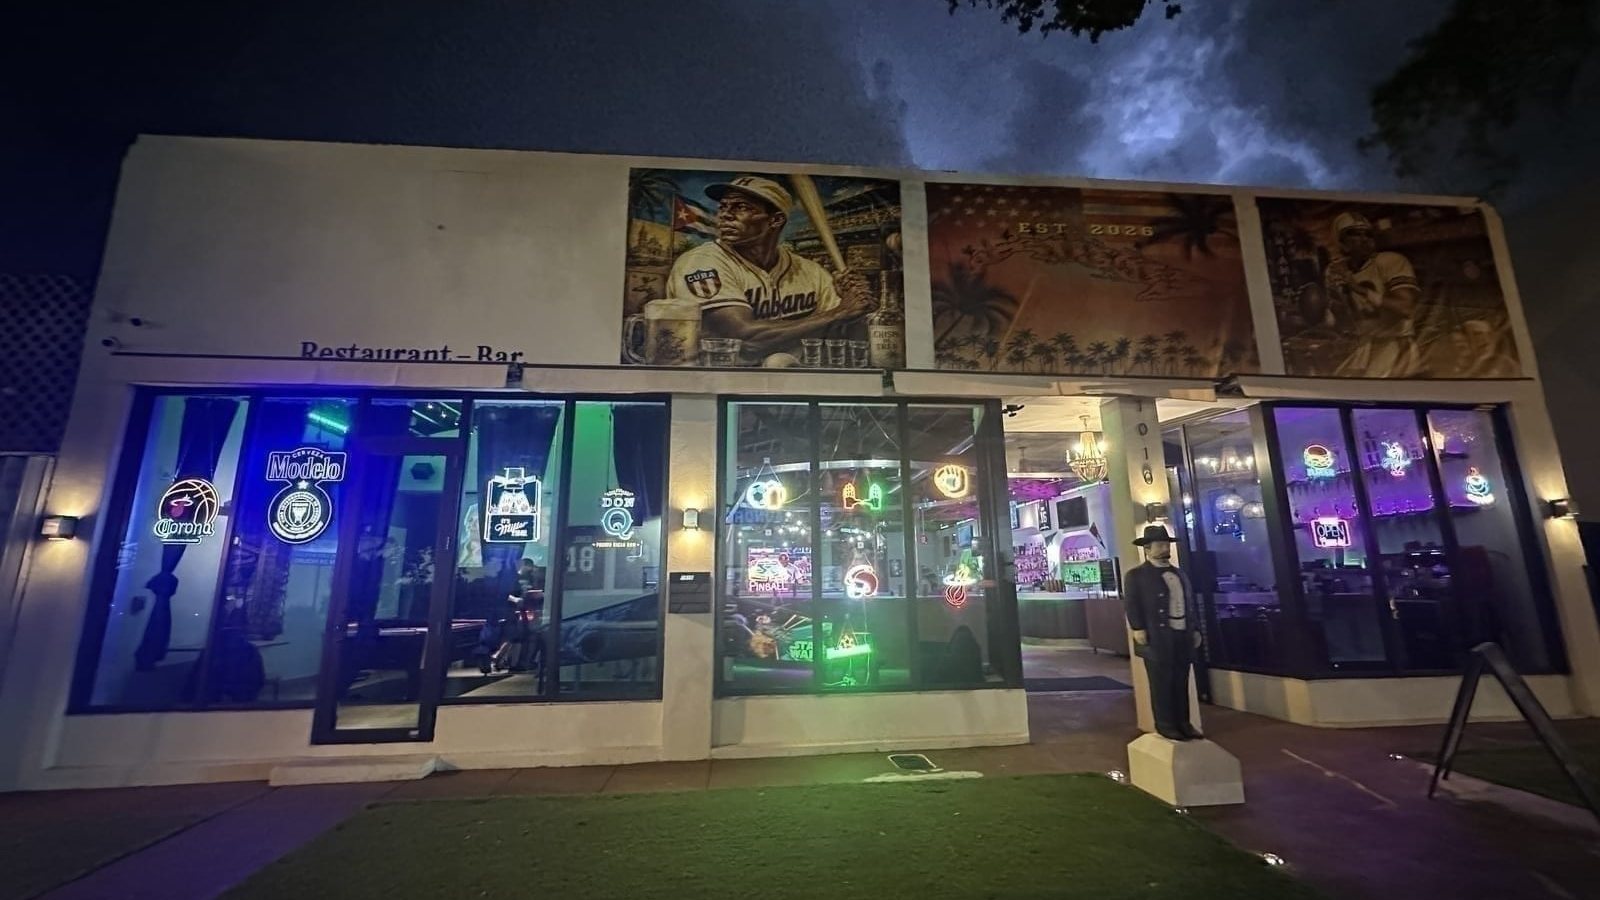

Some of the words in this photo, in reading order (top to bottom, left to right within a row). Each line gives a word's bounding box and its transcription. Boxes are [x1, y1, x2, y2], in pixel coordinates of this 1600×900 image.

[1018, 222, 1067, 234] EST
[1090, 224, 1153, 237] 2026
[687, 271, 715, 283] CUBA
[745, 288, 817, 320] Habana
[301, 341, 453, 361] Restaurant
[476, 344, 524, 362] Bar
[269, 454, 341, 480] Modelo
[601, 497, 636, 508] DON
[153, 518, 215, 539] Corona
[494, 521, 529, 537] Miller
[601, 507, 635, 541] Q
[1316, 524, 1345, 538] OPEN
[567, 546, 595, 573] 18
[749, 580, 789, 593] PINBALL
[789, 641, 814, 650] STA
